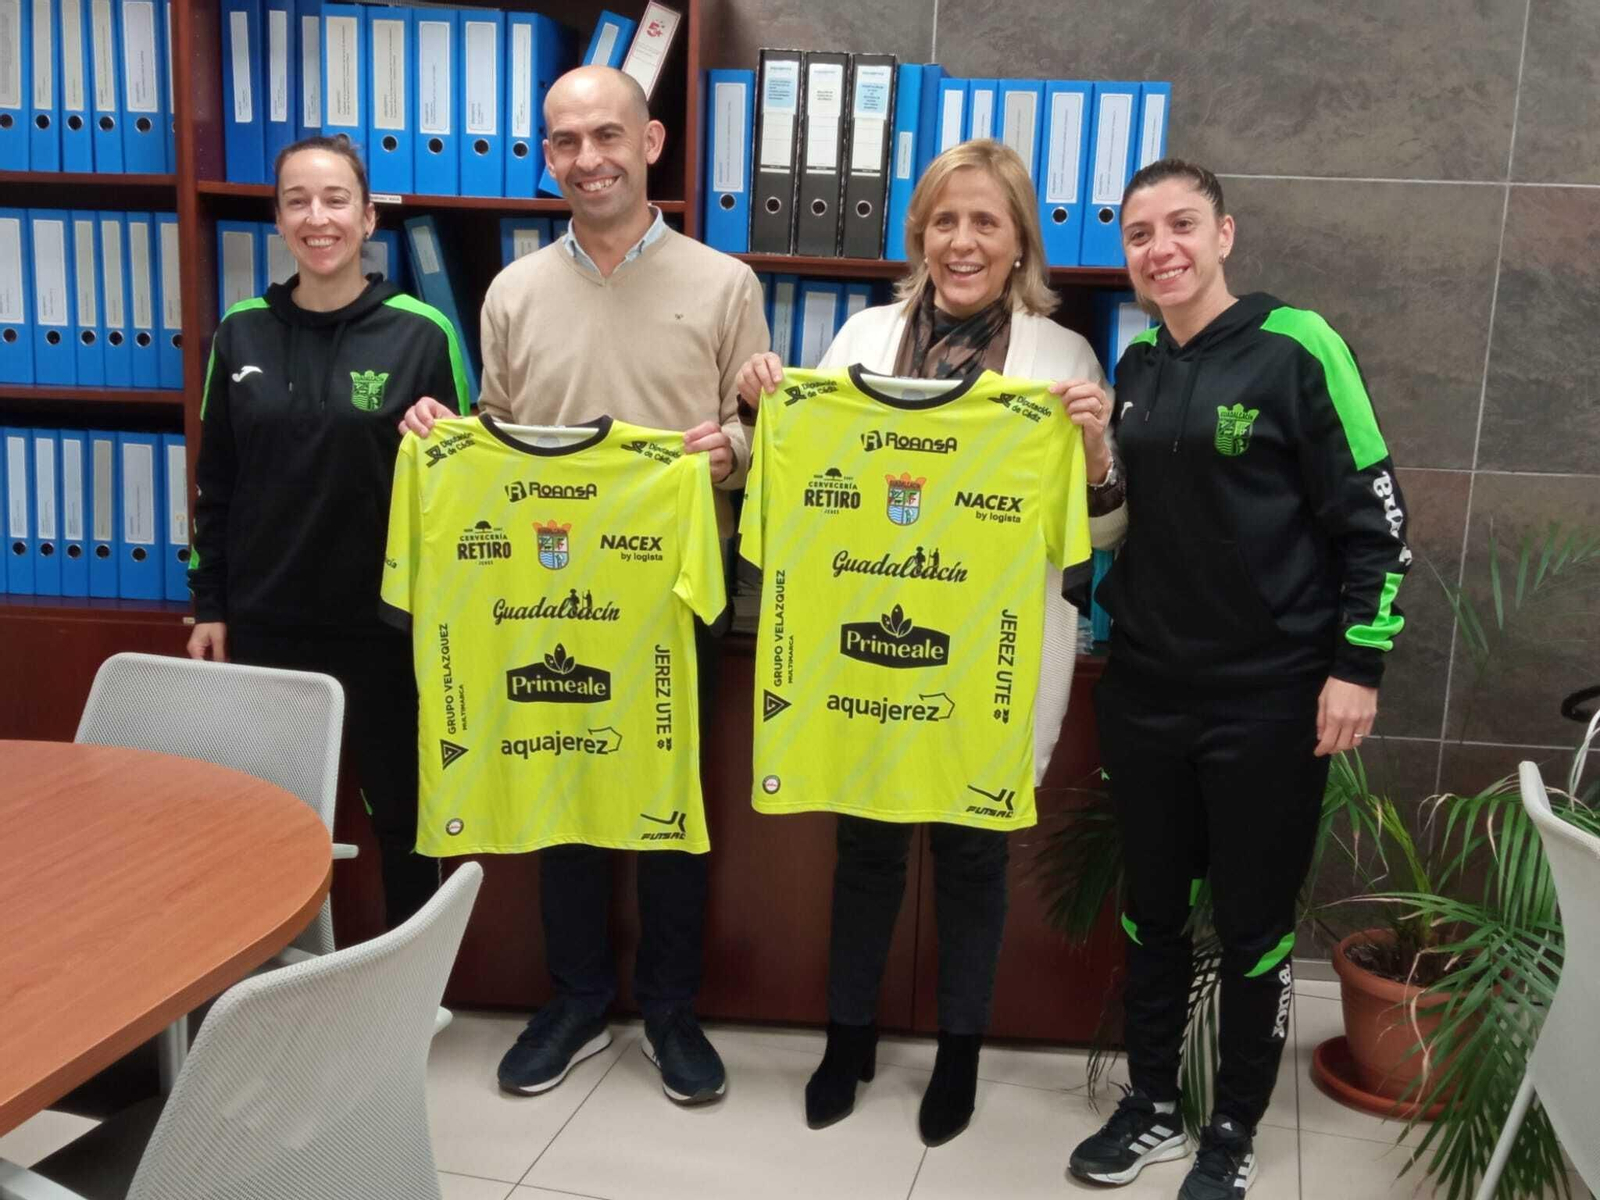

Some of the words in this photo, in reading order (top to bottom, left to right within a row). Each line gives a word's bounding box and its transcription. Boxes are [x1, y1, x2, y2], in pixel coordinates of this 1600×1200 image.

[1011, 405, 1021, 414] de
[804, 488, 862, 510] RETIRO
[954, 490, 1025, 513] NACEX
[975, 510, 988, 521] by
[989, 511, 1022, 524] logista
[457, 541, 512, 561] RETIRO
[600, 534, 664, 551] NACEX
[620, 552, 632, 562] by
[774, 569, 786, 643] VELAZQUEZ
[846, 630, 945, 661] Primeale
[997, 608, 1018, 667] JEREZ
[439, 622, 454, 693] VELAZQUEZ
[654, 643, 672, 698] JEREZ
[773, 645, 784, 688] GRUPO
[511, 674, 607, 697] Primeale
[993, 670, 1013, 706] UTE
[445, 694, 457, 735] GRUPO
[655, 702, 672, 735] UTE
[826, 694, 941, 725] aquajerez
[501, 730, 609, 760] aquajerez
